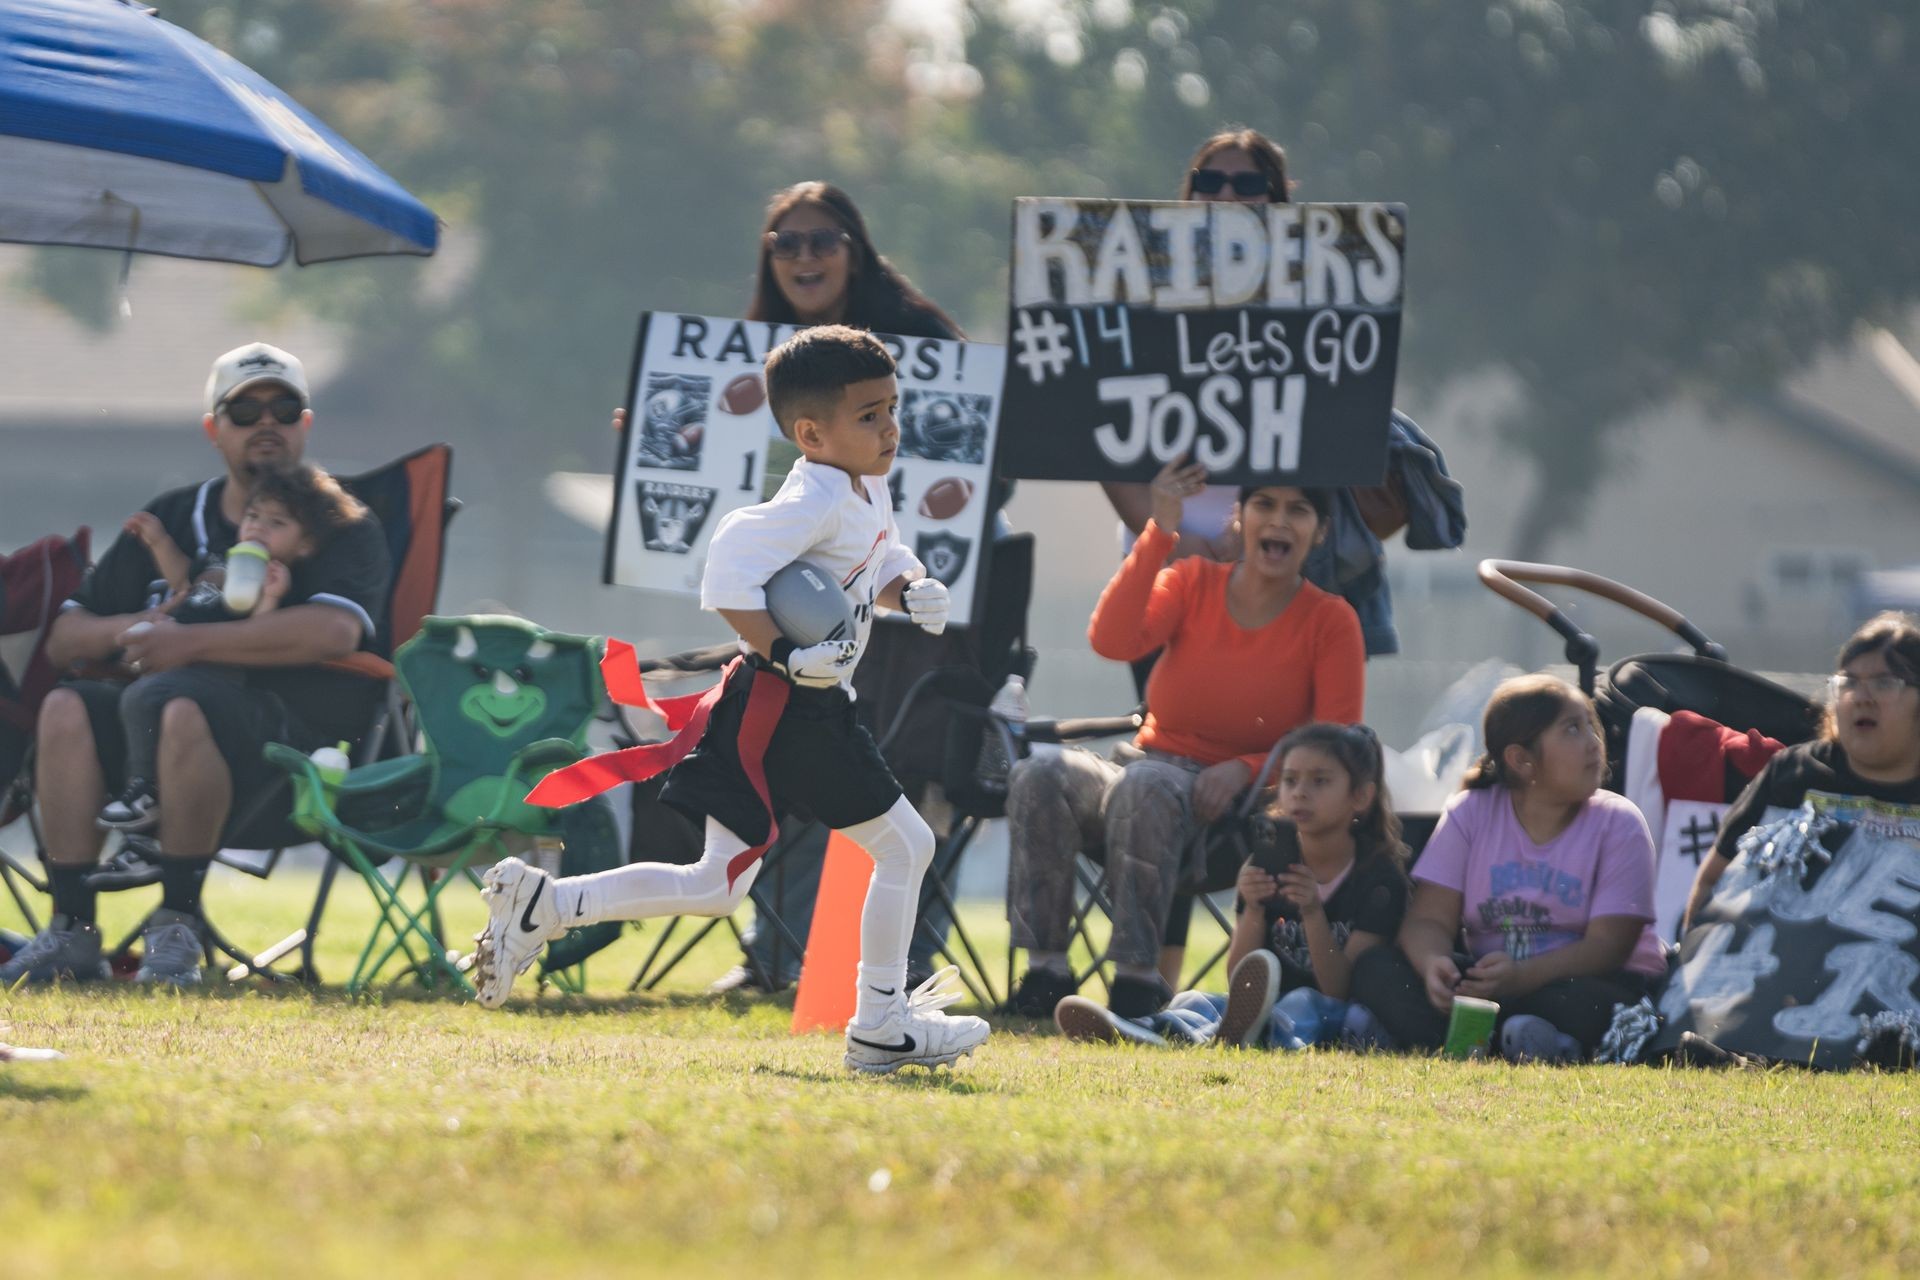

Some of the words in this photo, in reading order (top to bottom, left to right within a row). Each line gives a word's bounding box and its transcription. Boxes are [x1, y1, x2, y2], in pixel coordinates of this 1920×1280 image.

[1014, 201, 1402, 308] RAIDERS
[1013, 305, 1134, 384] #14
[1176, 309, 1293, 374] Lets
[1304, 308, 1381, 385] GO
[1094, 373, 1307, 472] JOSH
[644, 481, 712, 499] RAIDERS
[739, 452, 756, 491] 1
